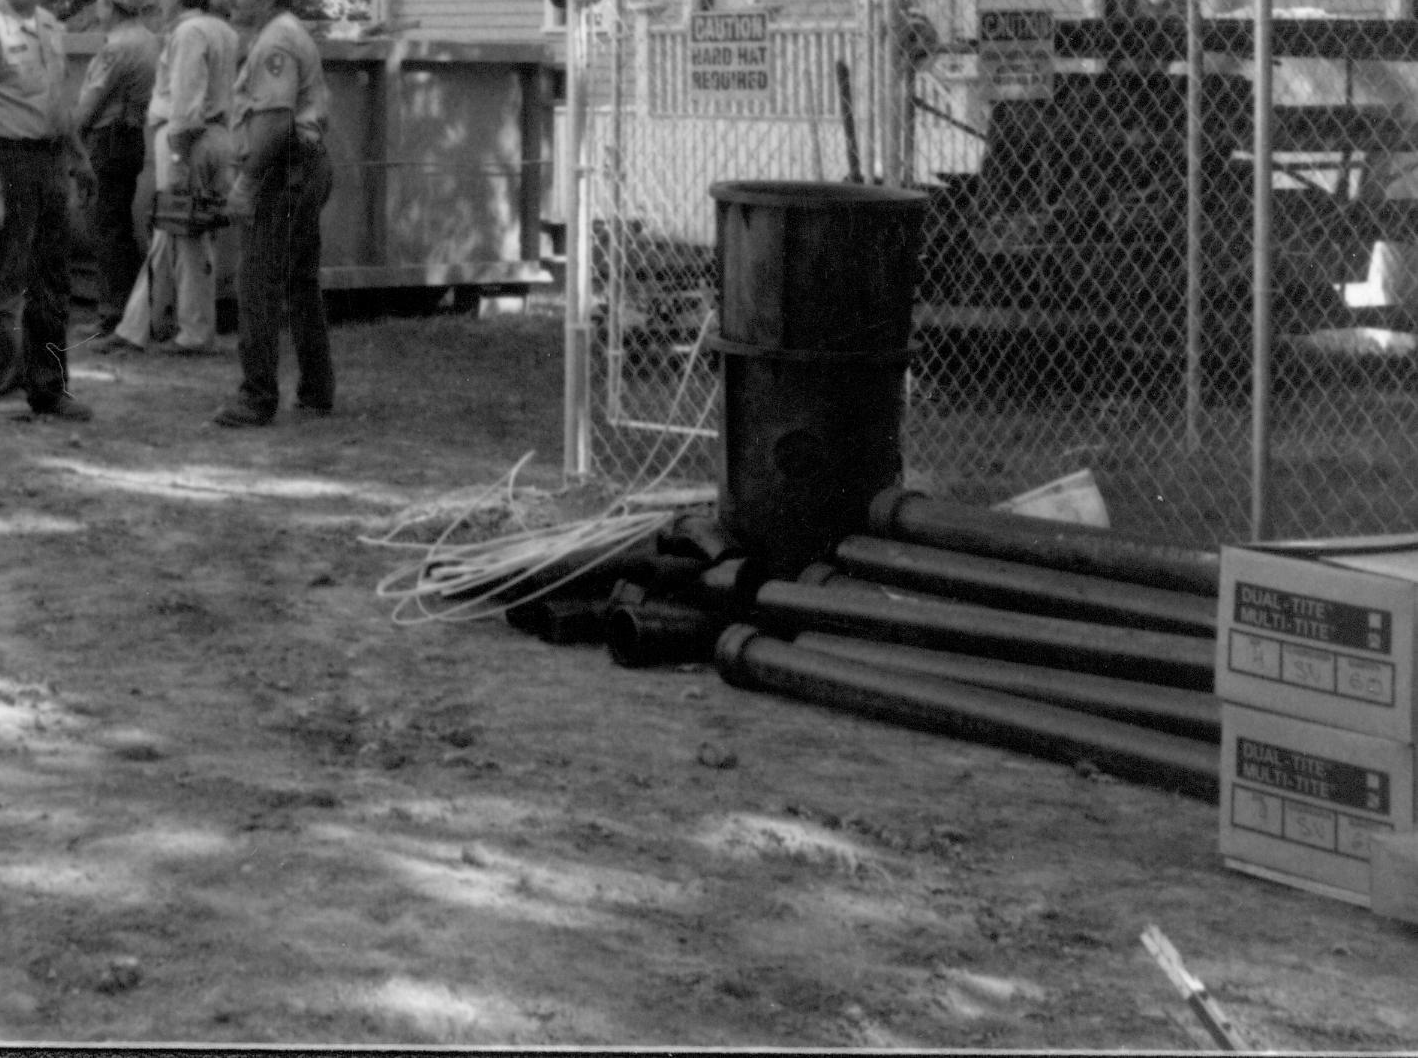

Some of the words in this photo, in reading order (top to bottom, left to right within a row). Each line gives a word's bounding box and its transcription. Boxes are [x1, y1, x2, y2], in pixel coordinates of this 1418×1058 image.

[694, 16, 763, 40] CAUTION
[692, 47, 732, 65] HARD
[738, 46, 767, 65] HAT
[692, 70, 768, 91] REQUIRED
